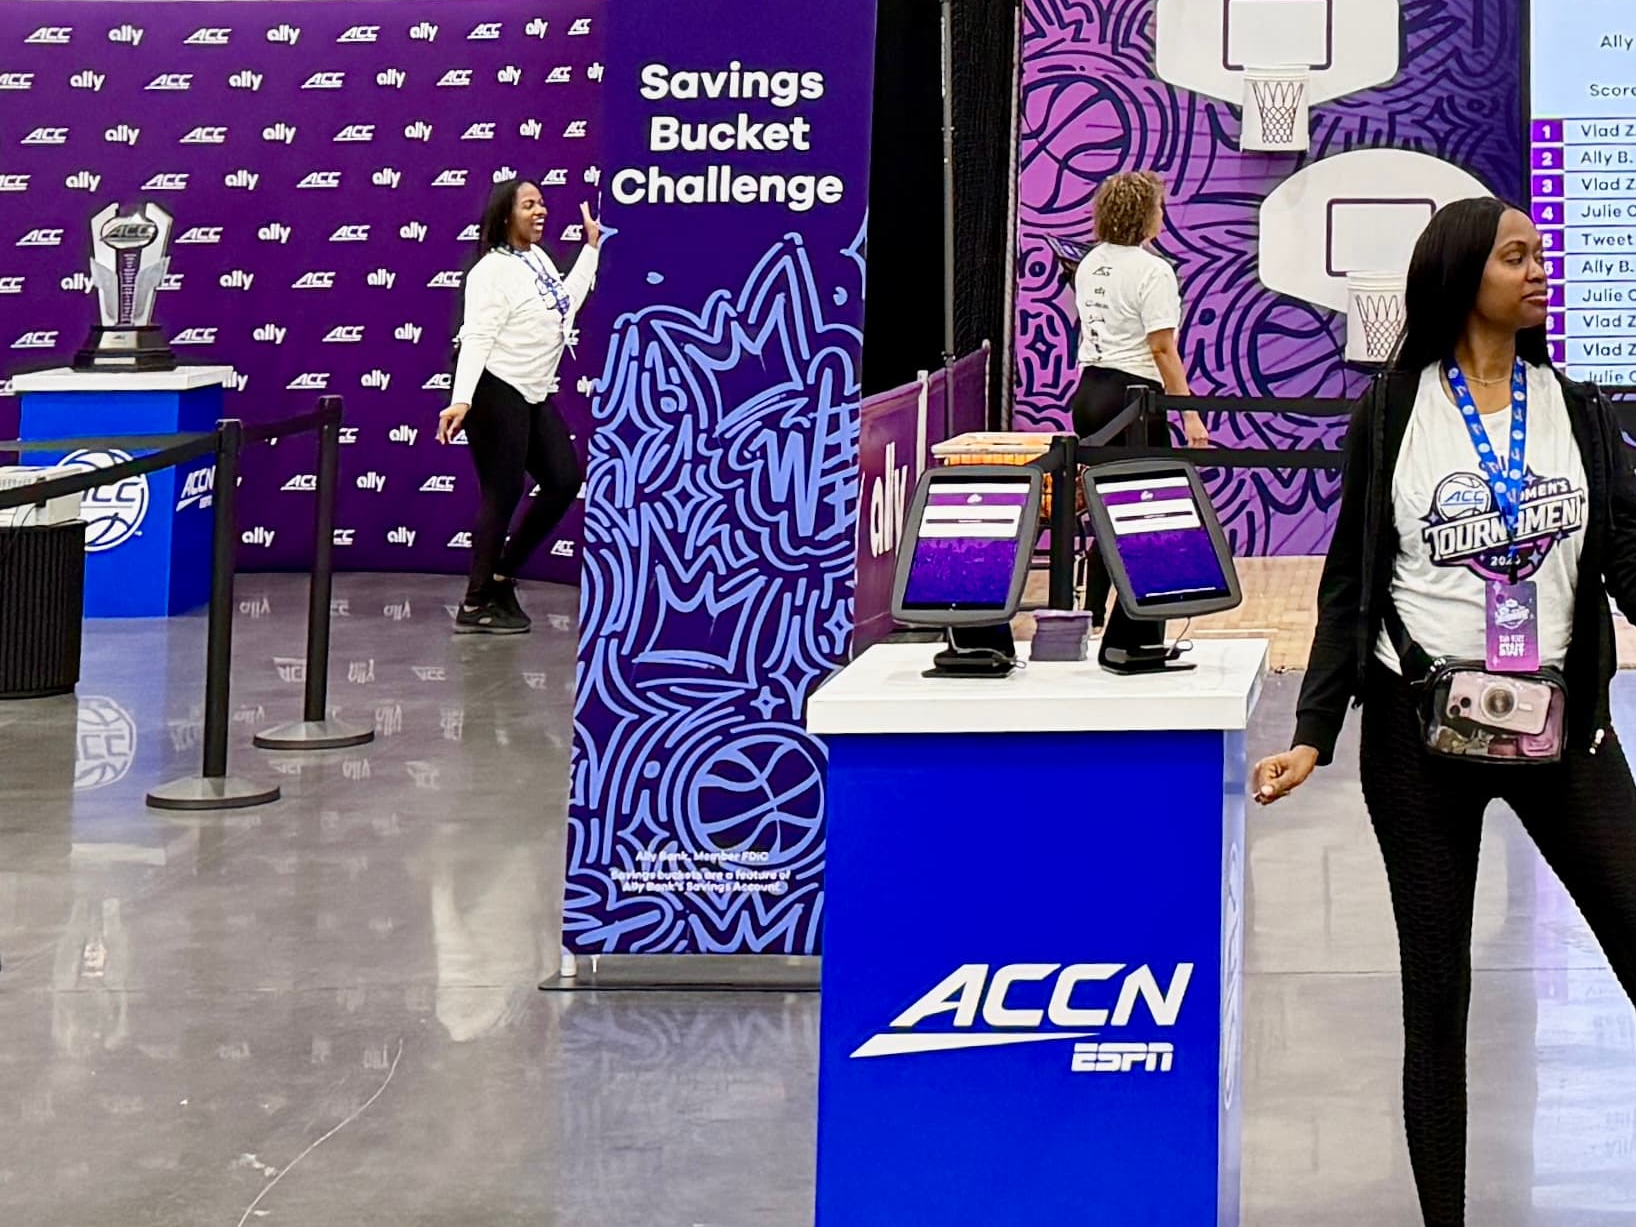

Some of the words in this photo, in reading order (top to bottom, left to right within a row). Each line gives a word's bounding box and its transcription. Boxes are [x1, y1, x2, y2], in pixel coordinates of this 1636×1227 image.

[339, 25, 381, 40] ACC
[409, 22, 439, 42] ally
[469, 22, 503, 37] ACC
[525, 18, 549, 39] ally
[570, 18, 592, 33] ACC
[26, 27, 73, 41] ACC
[108, 24, 144, 46] ally
[186, 28, 232, 42] ACC
[266, 24, 301, 46] ally
[1600, 35, 1634, 50] Ally
[147, 73, 194, 87] ACC
[228, 70, 263, 91] ally
[304, 72, 345, 86] ACC
[376, 68, 406, 89] ally
[439, 69, 473, 84] ACC
[497, 65, 522, 86] ally
[547, 66, 572, 80] ACC
[70, 70, 106, 92] ally
[640, 61, 825, 107] Savings
[23, 127, 69, 141] ACC
[104, 124, 140, 146] ally
[182, 126, 228, 140] ACC
[262, 123, 297, 144] ally
[336, 124, 375, 139] ACC
[404, 121, 433, 142] ally
[463, 122, 496, 137] ACC
[519, 119, 542, 140] ally
[565, 120, 587, 135] ACC
[650, 114, 810, 151] Bucket
[1542, 125, 1551, 139] 1
[1581, 124, 1620, 138] Vlad
[1542, 152, 1553, 166] 2
[1581, 151, 1612, 166] Ally
[1617, 151, 1634, 164] B.
[65, 171, 101, 192] ally
[143, 173, 190, 187] ACC
[224, 169, 259, 191] ally
[299, 171, 342, 186] ACC
[372, 167, 401, 189] ally
[434, 169, 468, 183] ACC
[543, 168, 569, 183] ACC
[611, 166, 844, 211] Challenge
[1542, 179, 1553, 193] 3
[1581, 178, 1620, 191] Vlad
[1542, 206, 1554, 220] 4
[1581, 204, 1622, 218] Julie
[18, 228, 64, 243] ACC
[177, 226, 224, 241] ACC
[257, 223, 291, 244] ally
[331, 224, 371, 239] ACC
[399, 221, 428, 242] ally
[562, 224, 584, 239] ACC
[1582, 233, 1633, 246] Tweet
[1582, 260, 1613, 276] Ally
[1619, 260, 1635, 273] B.
[219, 270, 254, 291] ally
[294, 271, 336, 286] ACC
[367, 268, 396, 289] ally
[429, 271, 463, 286] ACC
[1582, 288, 1623, 302] Julie
[1583, 315, 1622, 328] Vlad
[13, 330, 59, 346] ACC
[172, 327, 218, 342] ACC
[252, 323, 287, 345] ally
[325, 325, 365, 339] ACC
[394, 322, 423, 344] ally
[1583, 343, 1622, 356] Vlad
[288, 372, 330, 387] ACC
[360, 369, 391, 391] ally
[388, 425, 418, 446] ally
[180, 464, 217, 499] ACCN
[356, 471, 386, 493] ally
[422, 475, 456, 489] ACC
[1443, 489, 1485, 504] ACC
[241, 526, 275, 548] ally
[387, 526, 416, 547] ally
[553, 539, 575, 554] ACC
[886, 962, 1195, 1029] ACCN
[1070, 1041, 1175, 1073] ESPN
